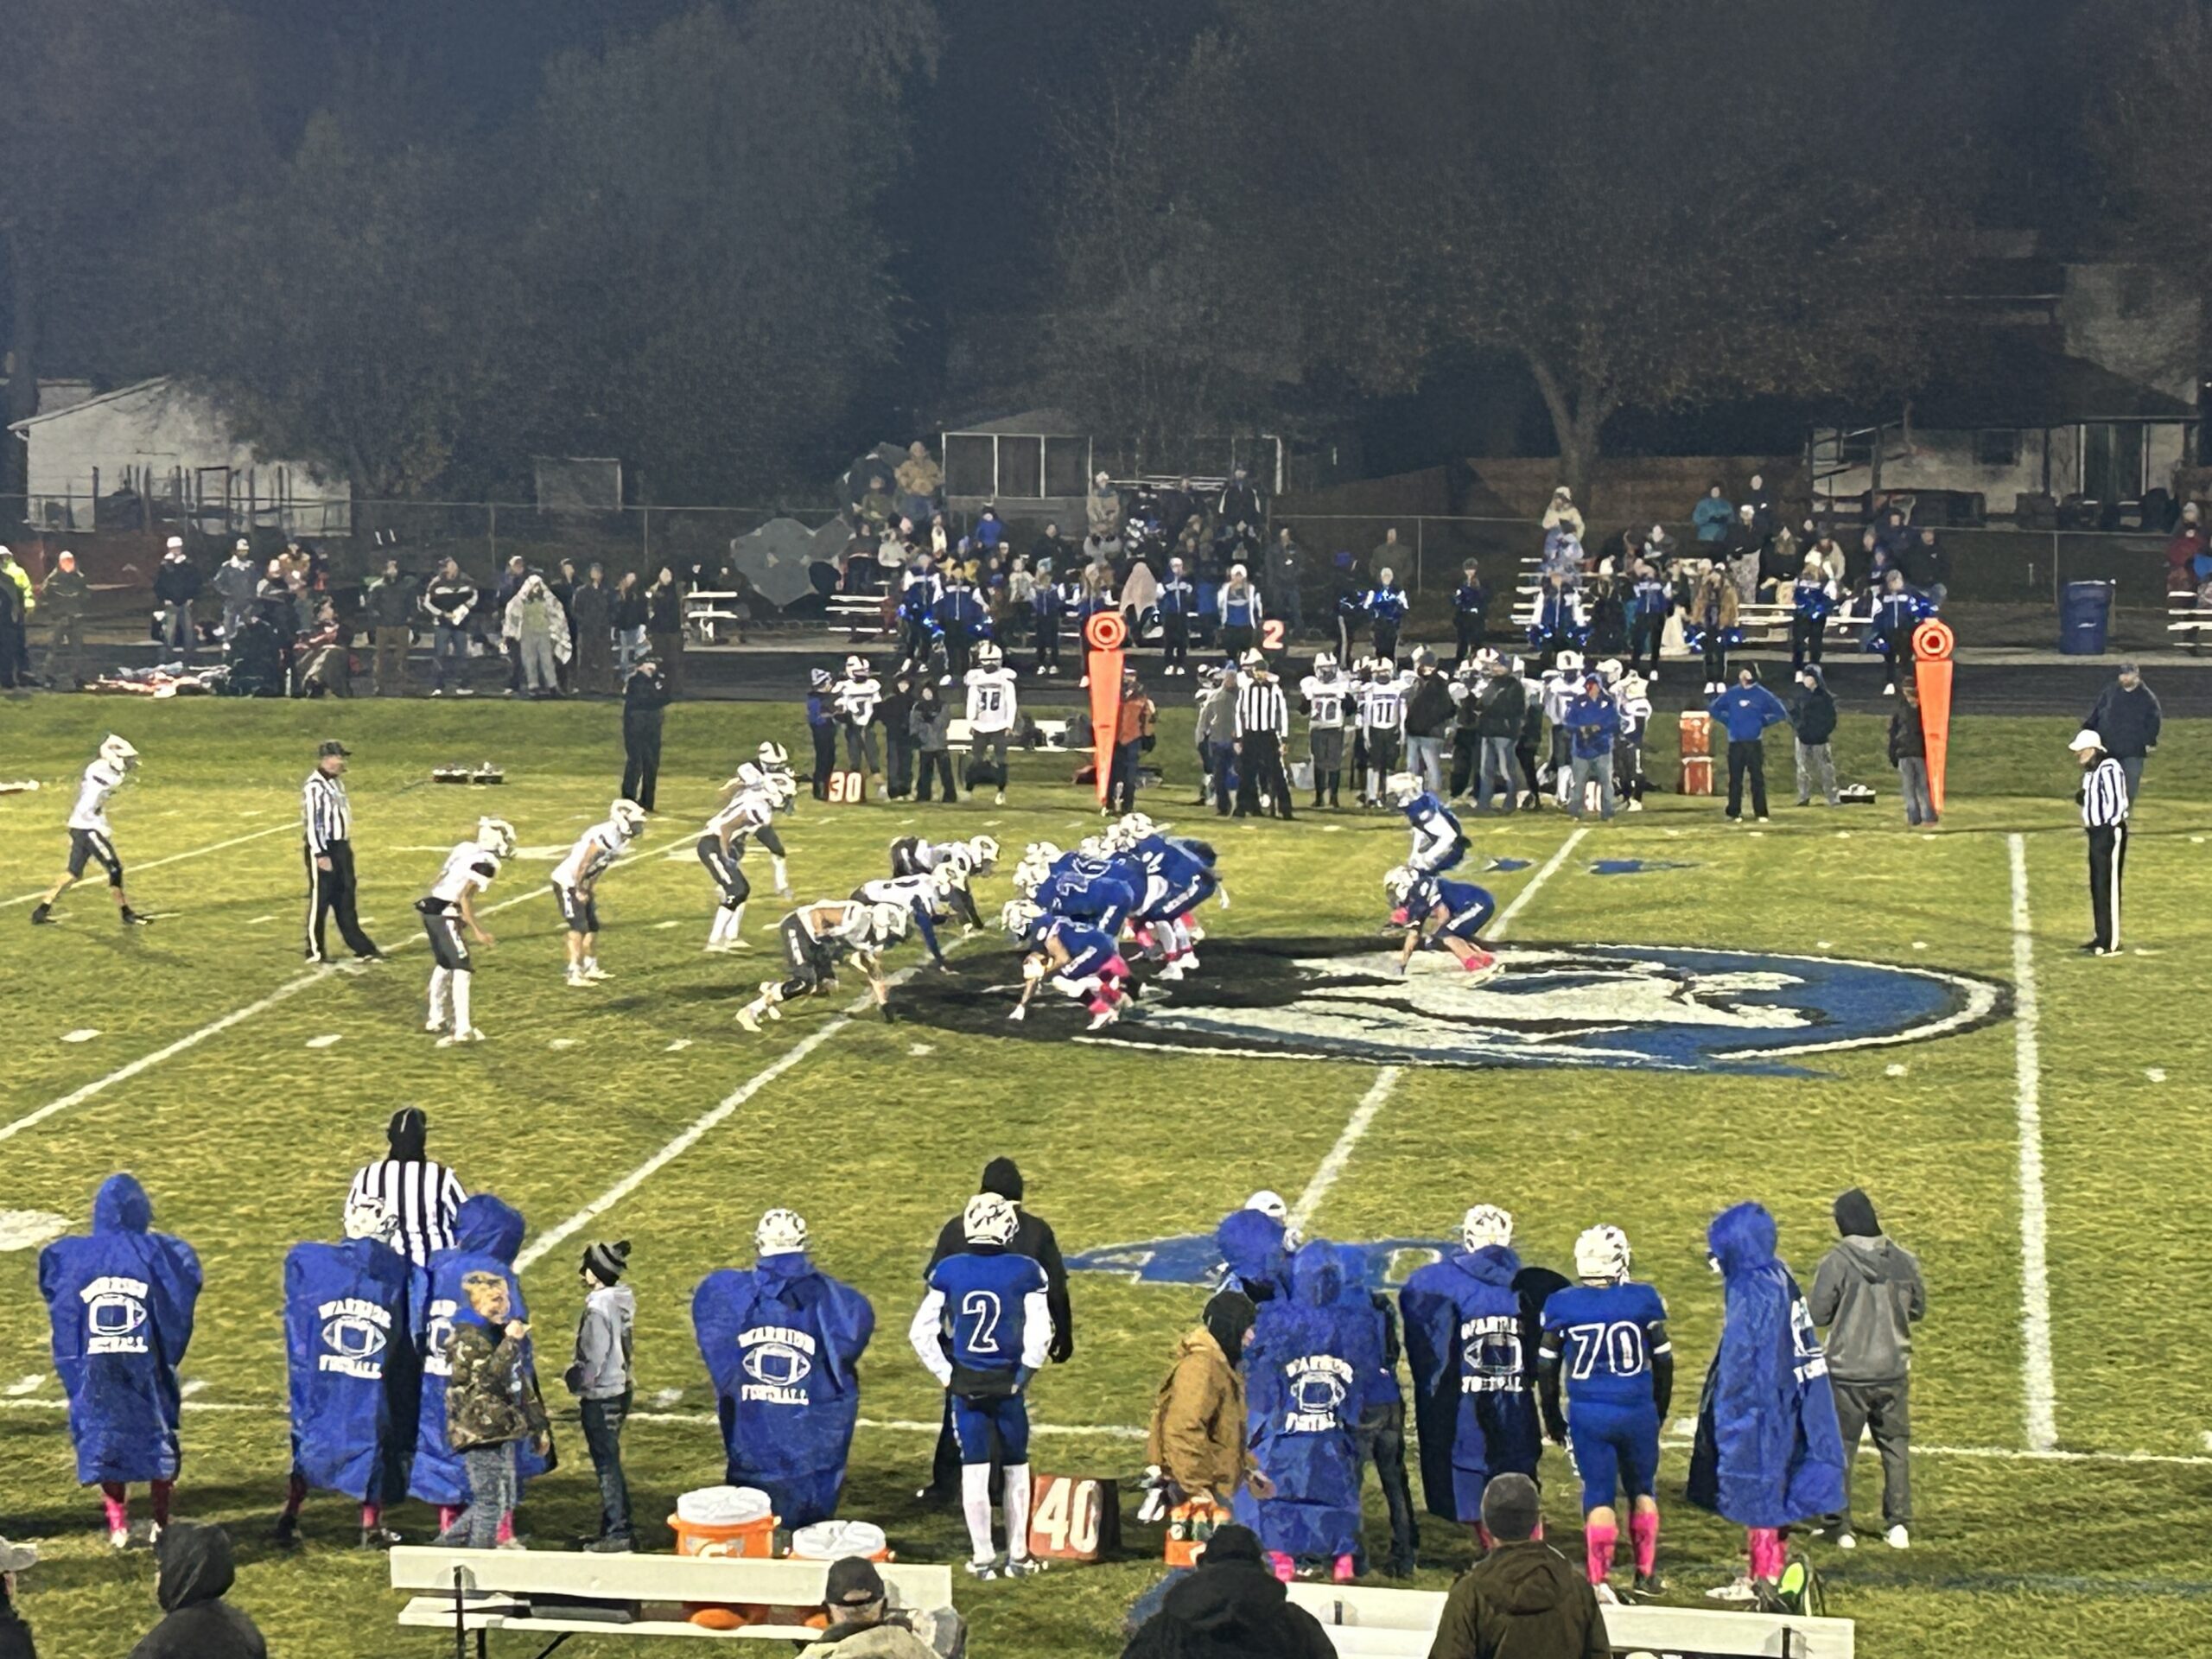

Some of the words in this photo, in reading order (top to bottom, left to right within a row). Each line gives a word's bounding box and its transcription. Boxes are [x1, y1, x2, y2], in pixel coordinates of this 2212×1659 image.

[1262, 619, 1284, 649] 2
[828, 771, 862, 803] 30
[962, 1290, 1001, 1353] 2
[1567, 1320, 1643, 1380] 70
[1033, 1476, 1103, 1554] 40
